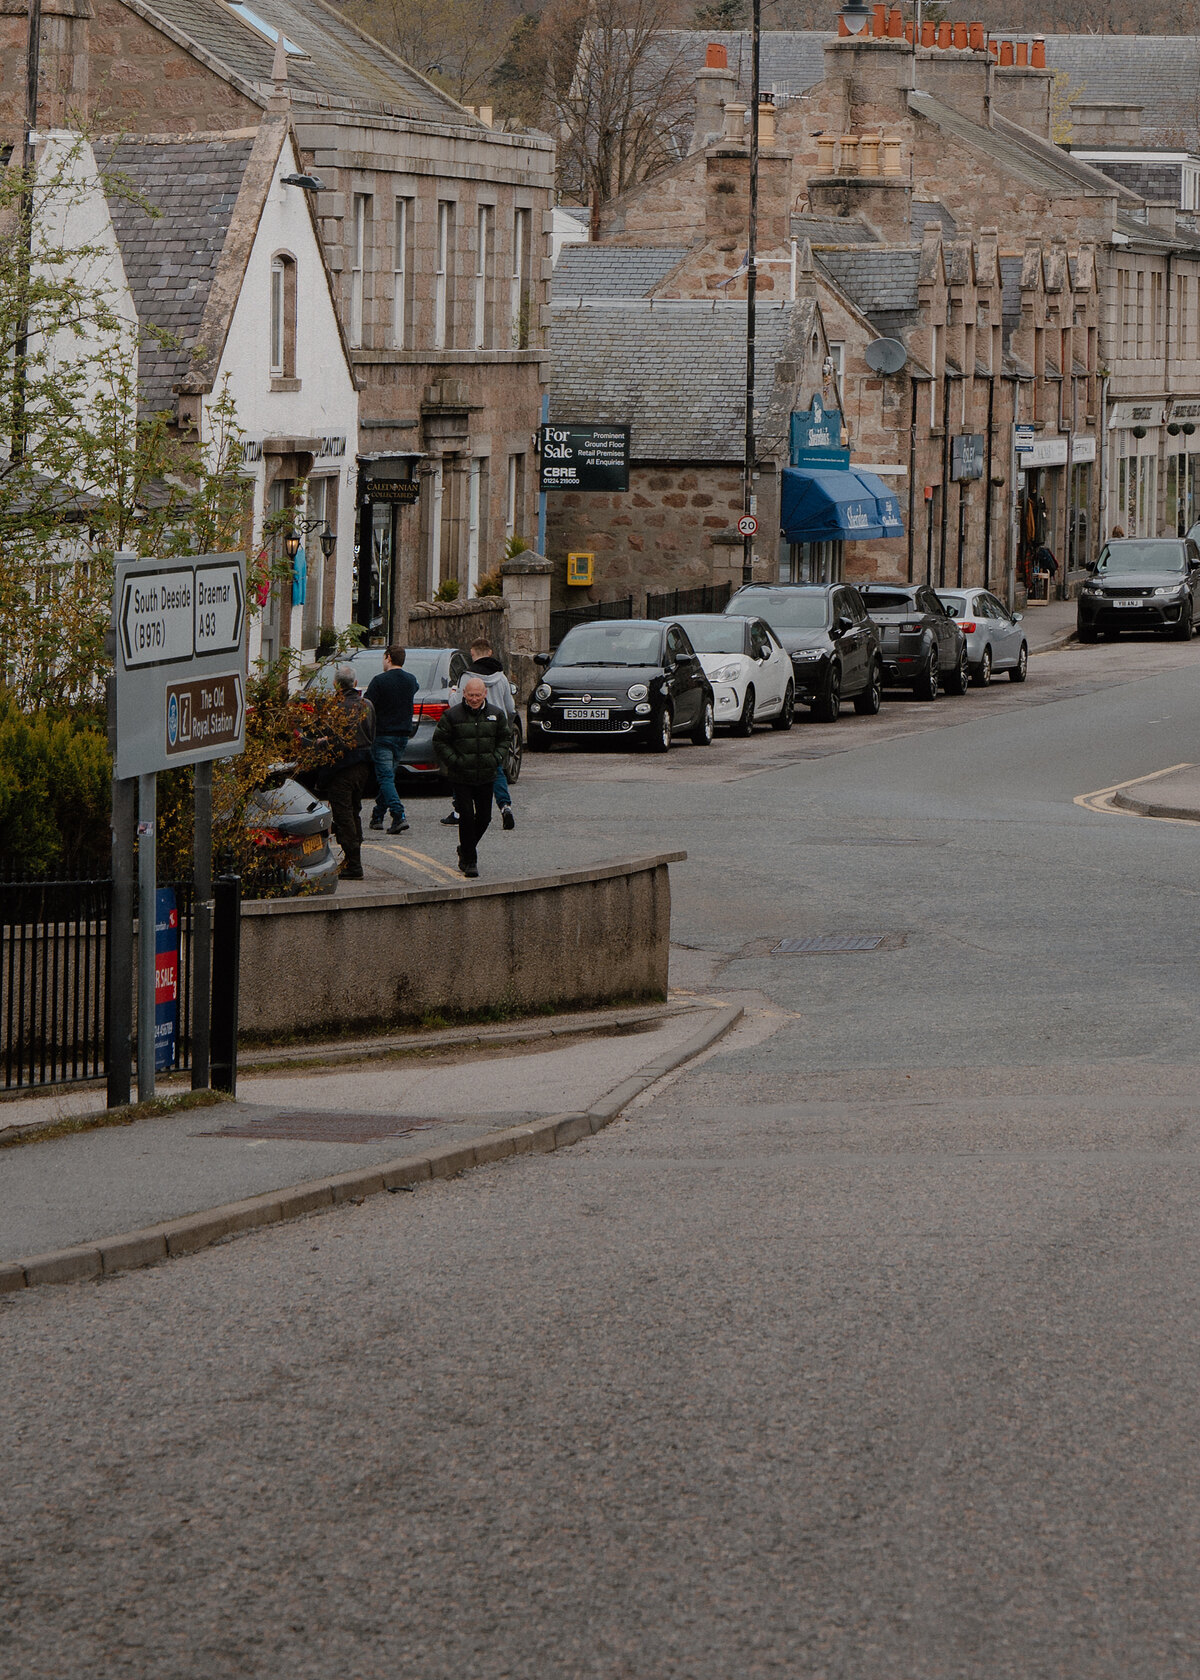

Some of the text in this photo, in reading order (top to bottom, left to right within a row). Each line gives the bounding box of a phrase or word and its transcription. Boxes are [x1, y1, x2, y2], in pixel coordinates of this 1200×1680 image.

[544, 427, 571, 442] For
[544, 443, 573, 459] Sale
[577, 449, 596, 457] Retail
[543, 468, 577, 477] CBRE
[366, 483, 418, 491] CALEDONIAN
[741, 521, 755, 530] 20
[134, 583, 191, 614] South Deeside
[199, 582, 231, 606] Braemar
[199, 612, 216, 638] A93
[134, 618, 165, 652] (B976)
[201, 685, 225, 710] The Old
[567, 710, 606, 718] ES09 ASH
[192, 711, 233, 740] Royal Station
[161, 966, 173, 988] SALE
